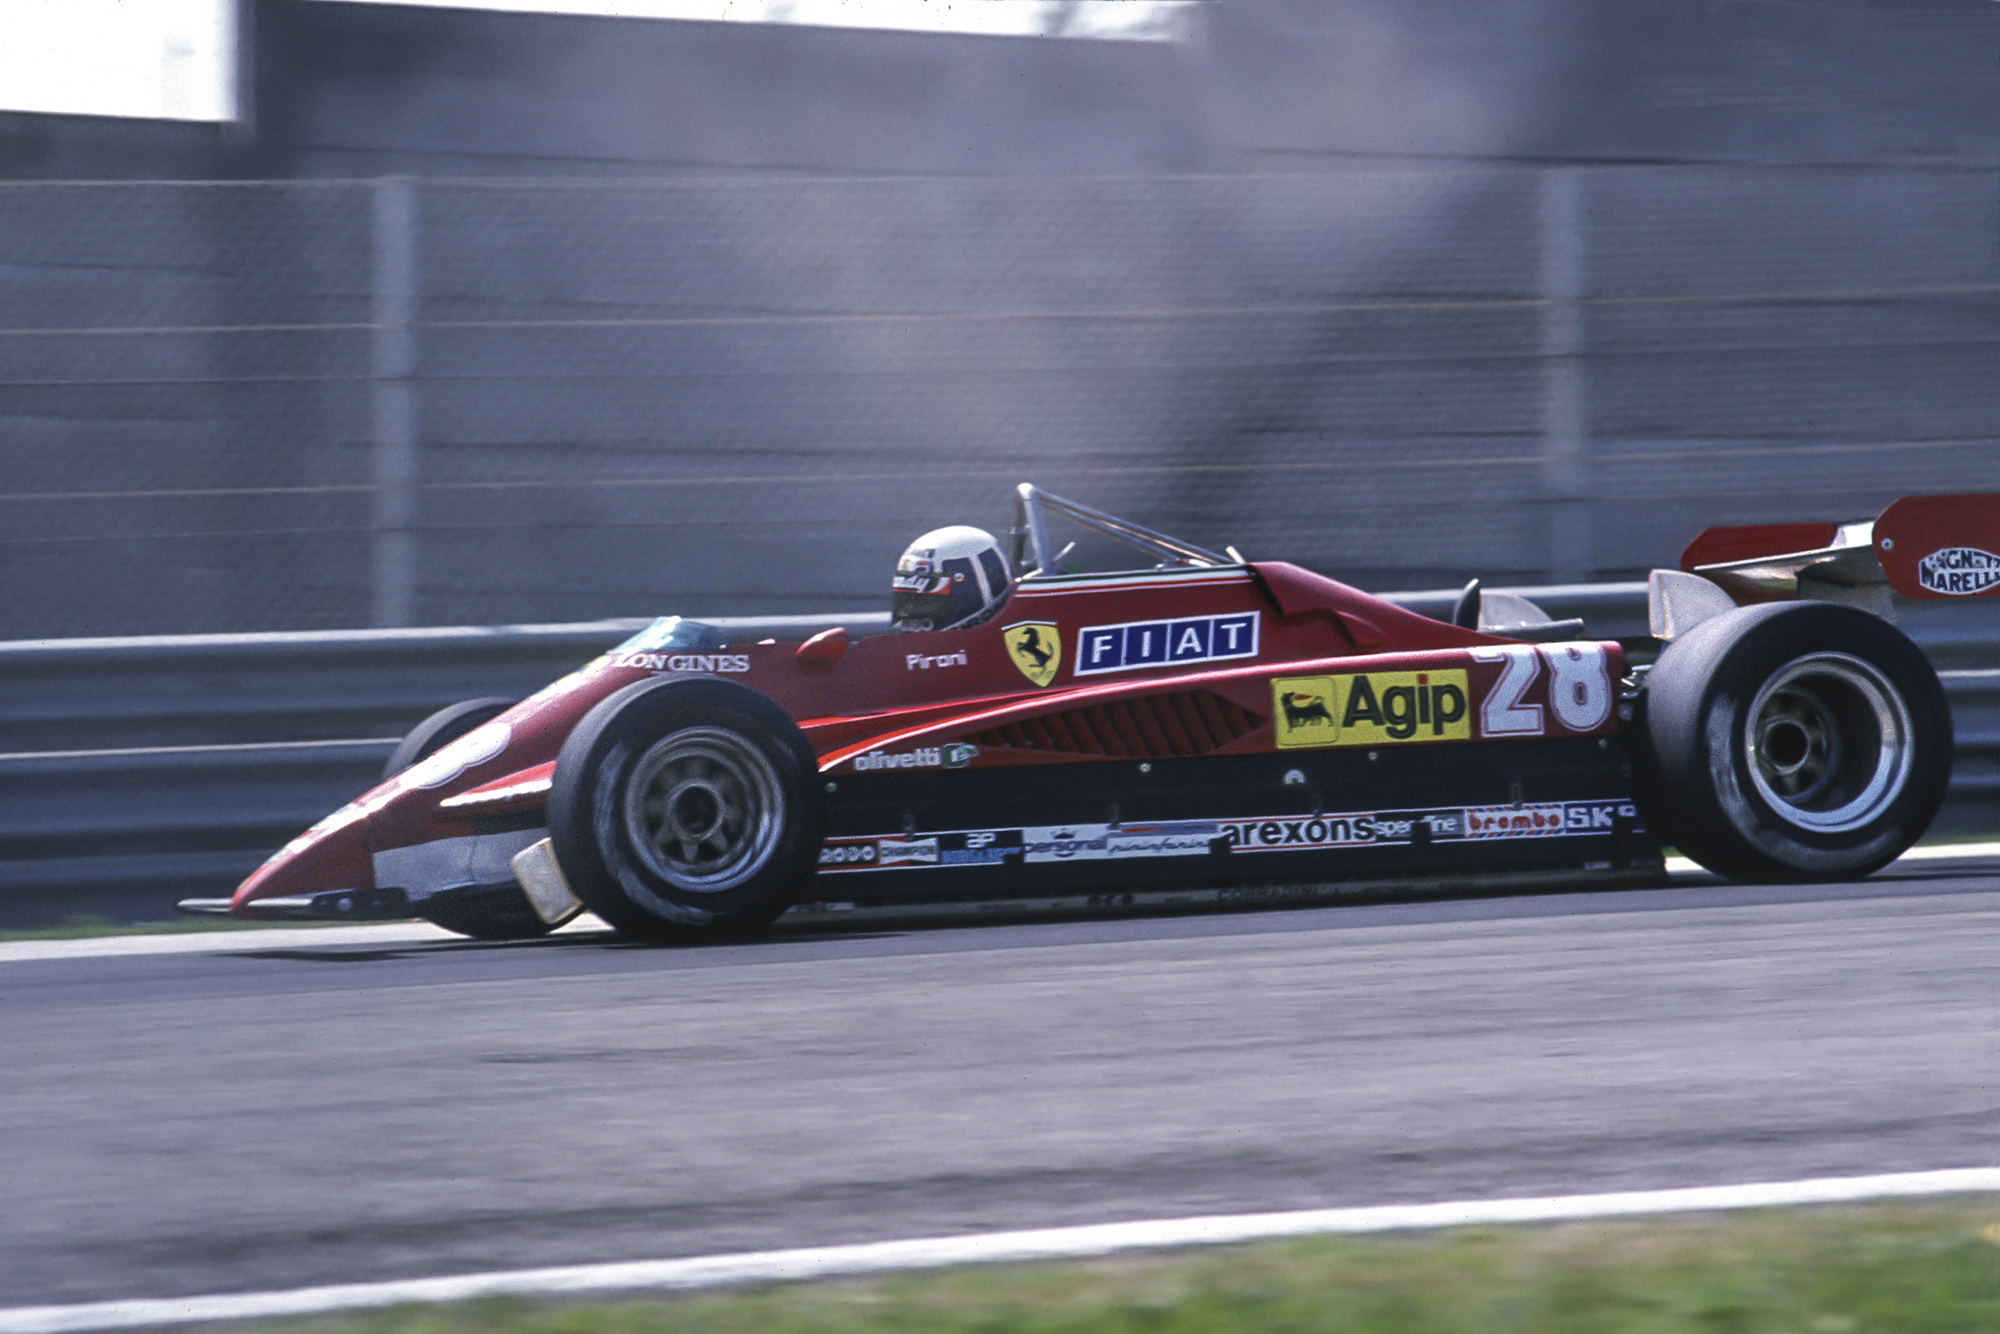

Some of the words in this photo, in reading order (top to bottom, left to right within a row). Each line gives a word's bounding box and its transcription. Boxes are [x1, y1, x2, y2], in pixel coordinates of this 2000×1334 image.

[1091, 622, 1248, 664] FIAT
[614, 653, 749, 672] LONGINES
[905, 649, 968, 671] Pironi
[1468, 643, 1612, 738] 28
[1342, 674, 1466, 740] Agip
[854, 747, 942, 771] olivetti
[1222, 817, 1374, 846] arexons
[1469, 811, 1561, 831] brembo
